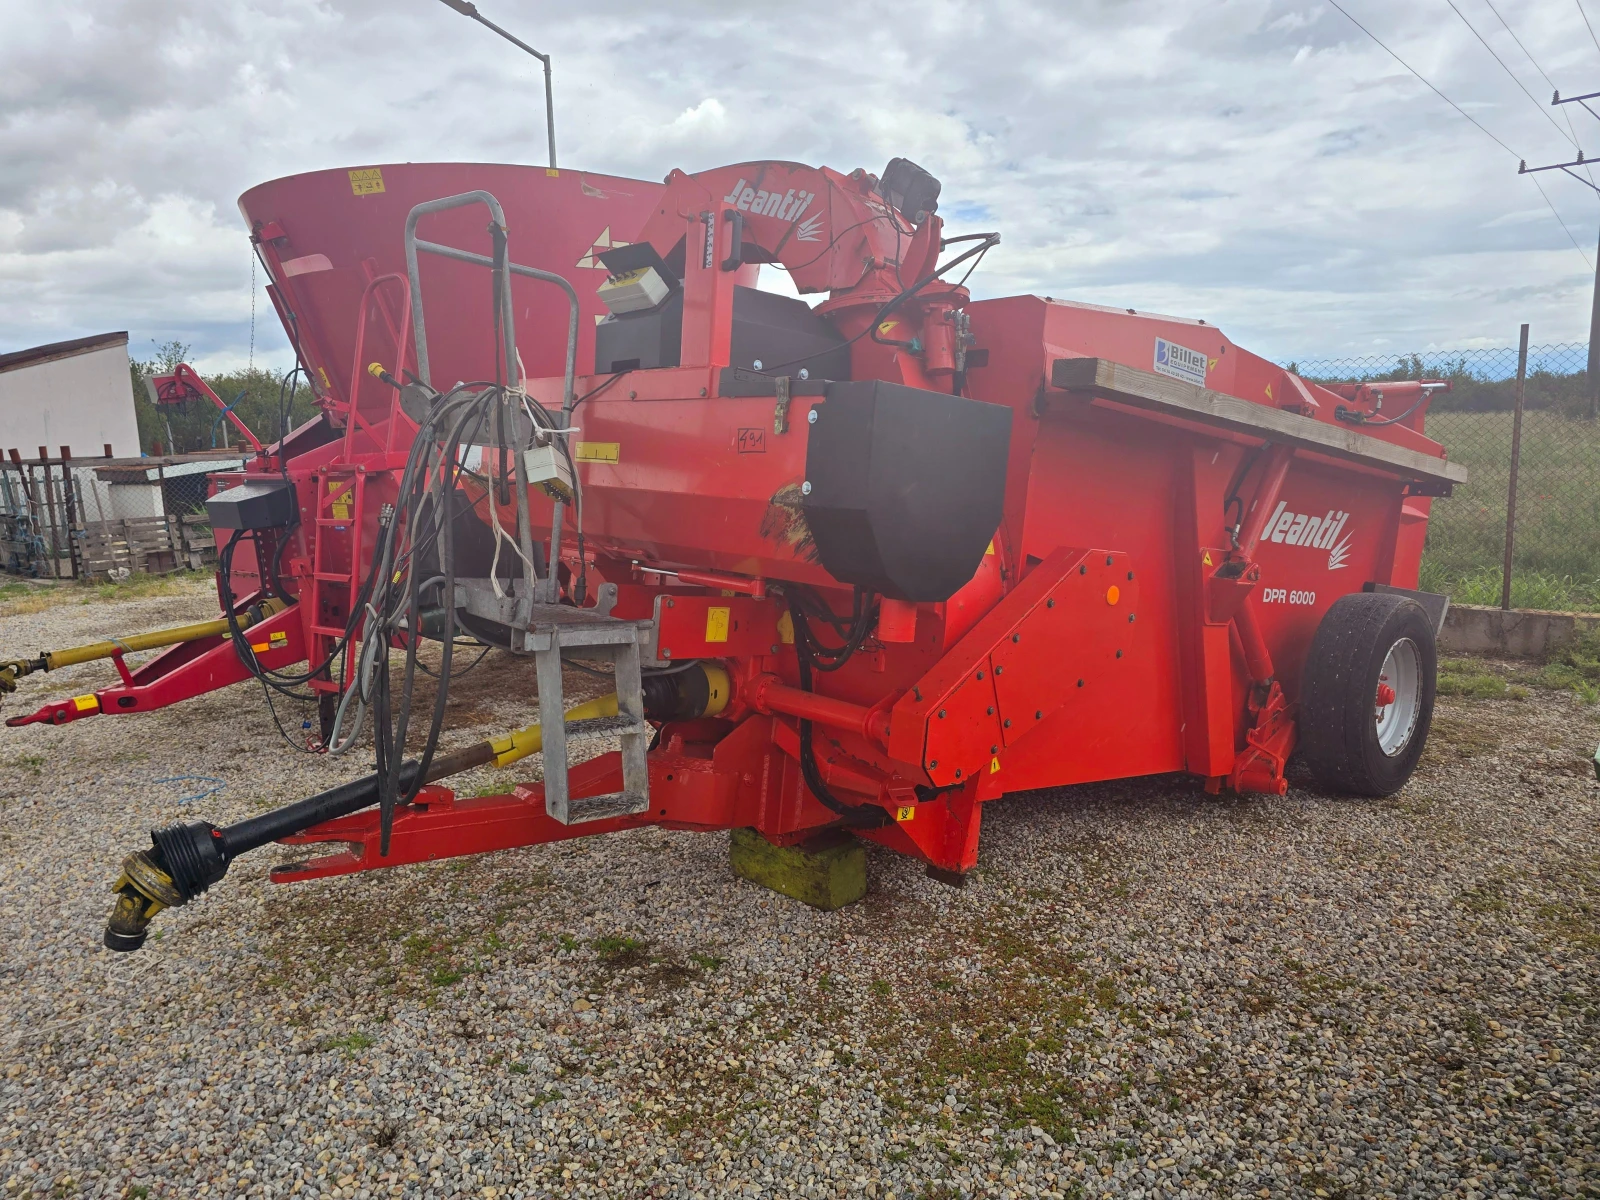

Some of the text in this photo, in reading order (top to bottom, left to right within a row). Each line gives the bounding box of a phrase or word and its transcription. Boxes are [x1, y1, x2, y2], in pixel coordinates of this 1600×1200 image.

[723, 178, 815, 223] Jeantil
[1170, 360, 1205, 376] EQUIPEMENT
[1171, 345, 1205, 369] Billet
[739, 429, 763, 449] 491
[1260, 500, 1350, 550] Jeantil
[1263, 587, 1316, 606] DPR 6000
